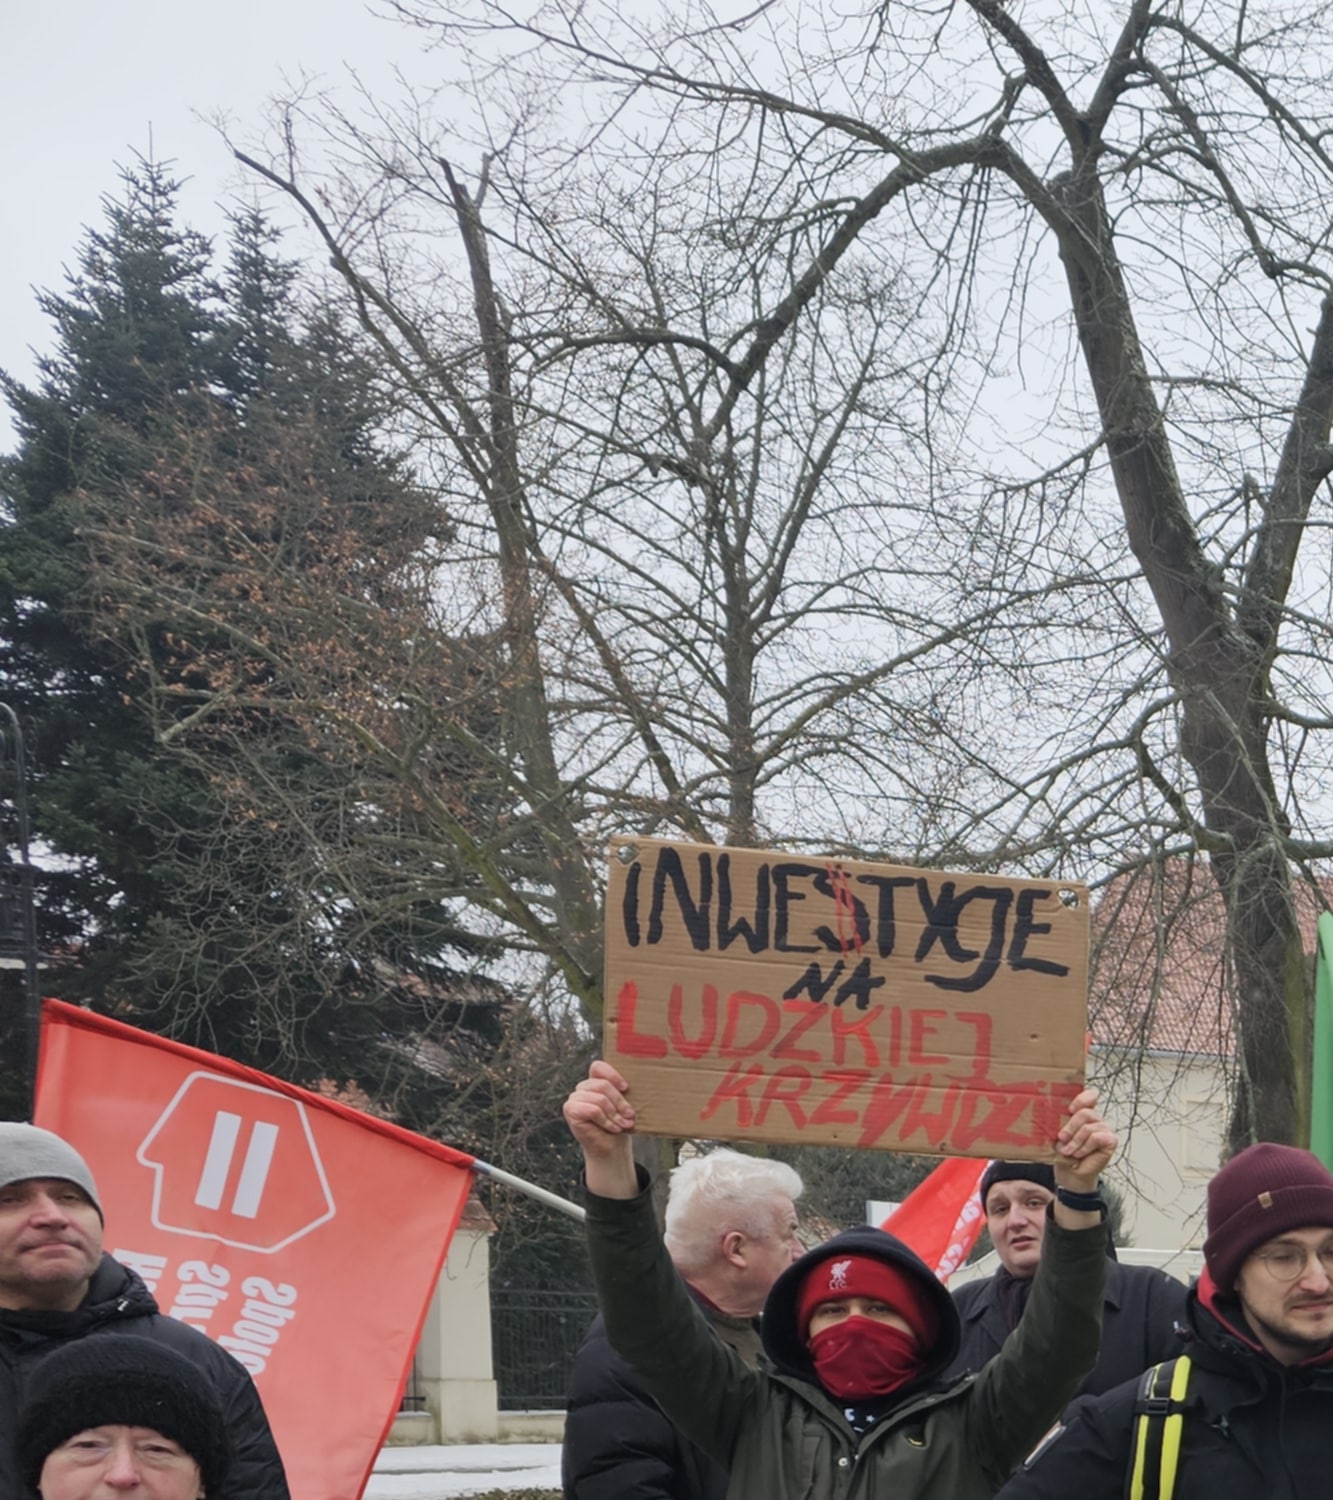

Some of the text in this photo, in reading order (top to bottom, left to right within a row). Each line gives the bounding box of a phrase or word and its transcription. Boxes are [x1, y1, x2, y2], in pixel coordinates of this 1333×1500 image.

[623, 847, 1070, 993] INWESTYCJE
[616, 979, 992, 1082] LUDZKIEJ
[783, 957, 885, 1010] NA
